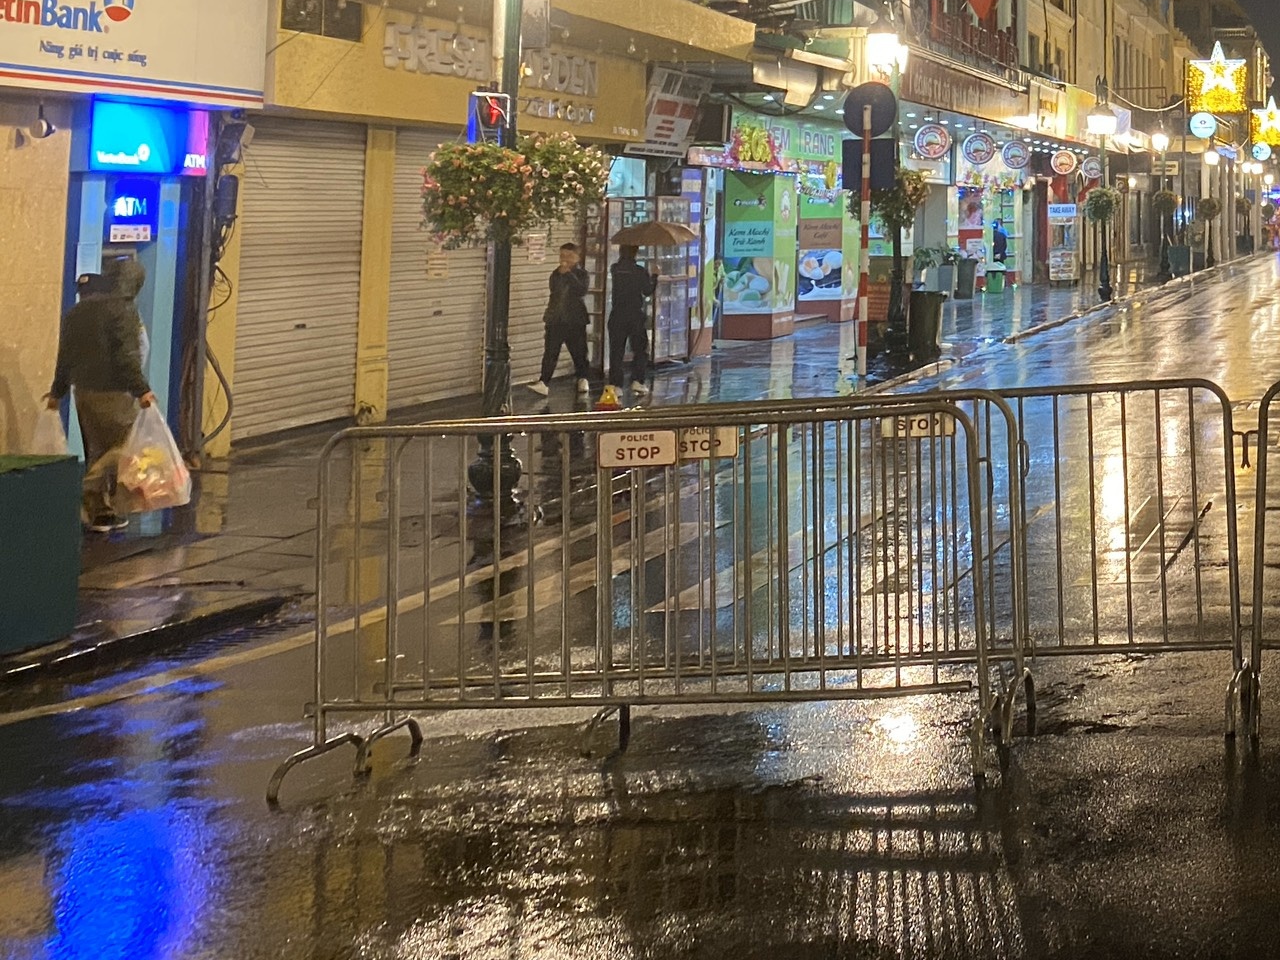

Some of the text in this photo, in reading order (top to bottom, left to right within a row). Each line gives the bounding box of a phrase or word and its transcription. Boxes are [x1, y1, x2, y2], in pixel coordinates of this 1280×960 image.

[382, 22, 600, 98] FRESH ARDEN
[184, 153, 205, 168] ATM
[114, 197, 147, 216] ATM
[620, 434, 655, 442] POLICE
[615, 446, 660, 460] STOP
